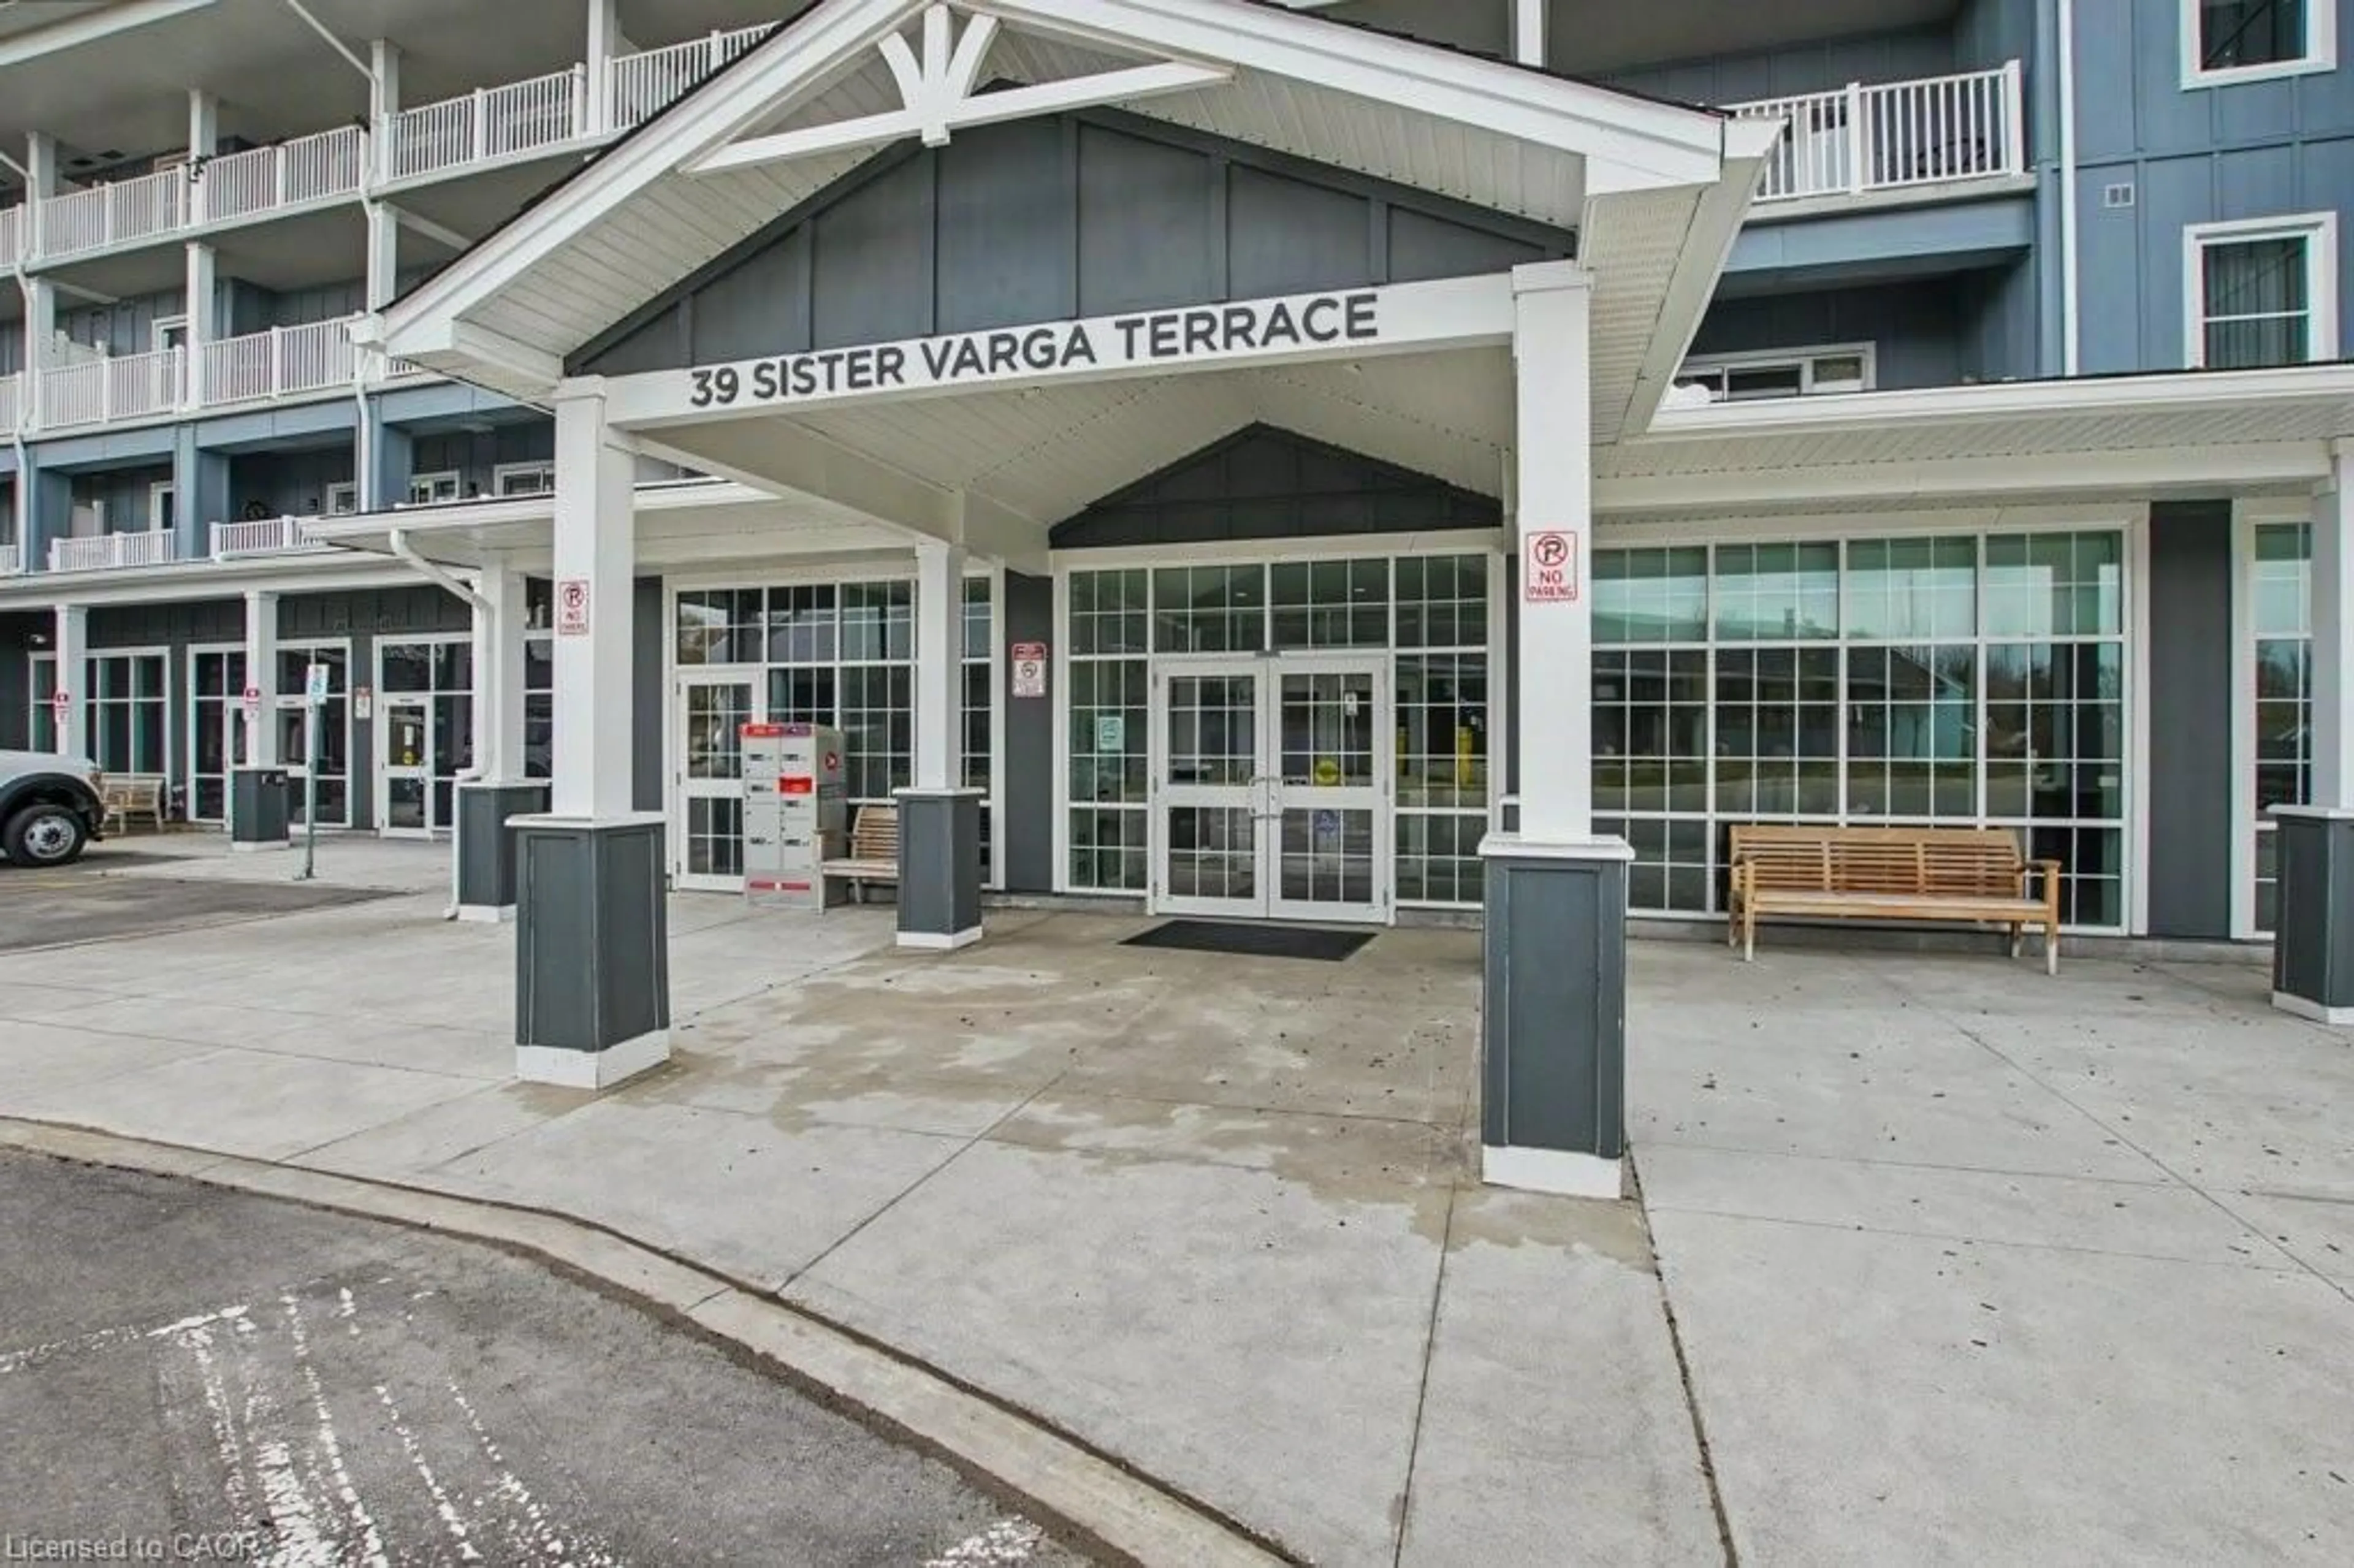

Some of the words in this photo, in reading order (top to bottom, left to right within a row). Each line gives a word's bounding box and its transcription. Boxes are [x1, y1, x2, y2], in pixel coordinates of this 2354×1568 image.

[690, 367, 739, 407] 39
[753, 347, 905, 399] SISTER
[920, 323, 1097, 380] VARGA
[1114, 294, 1379, 360] TERRACE
[1539, 569, 1563, 584] NO
